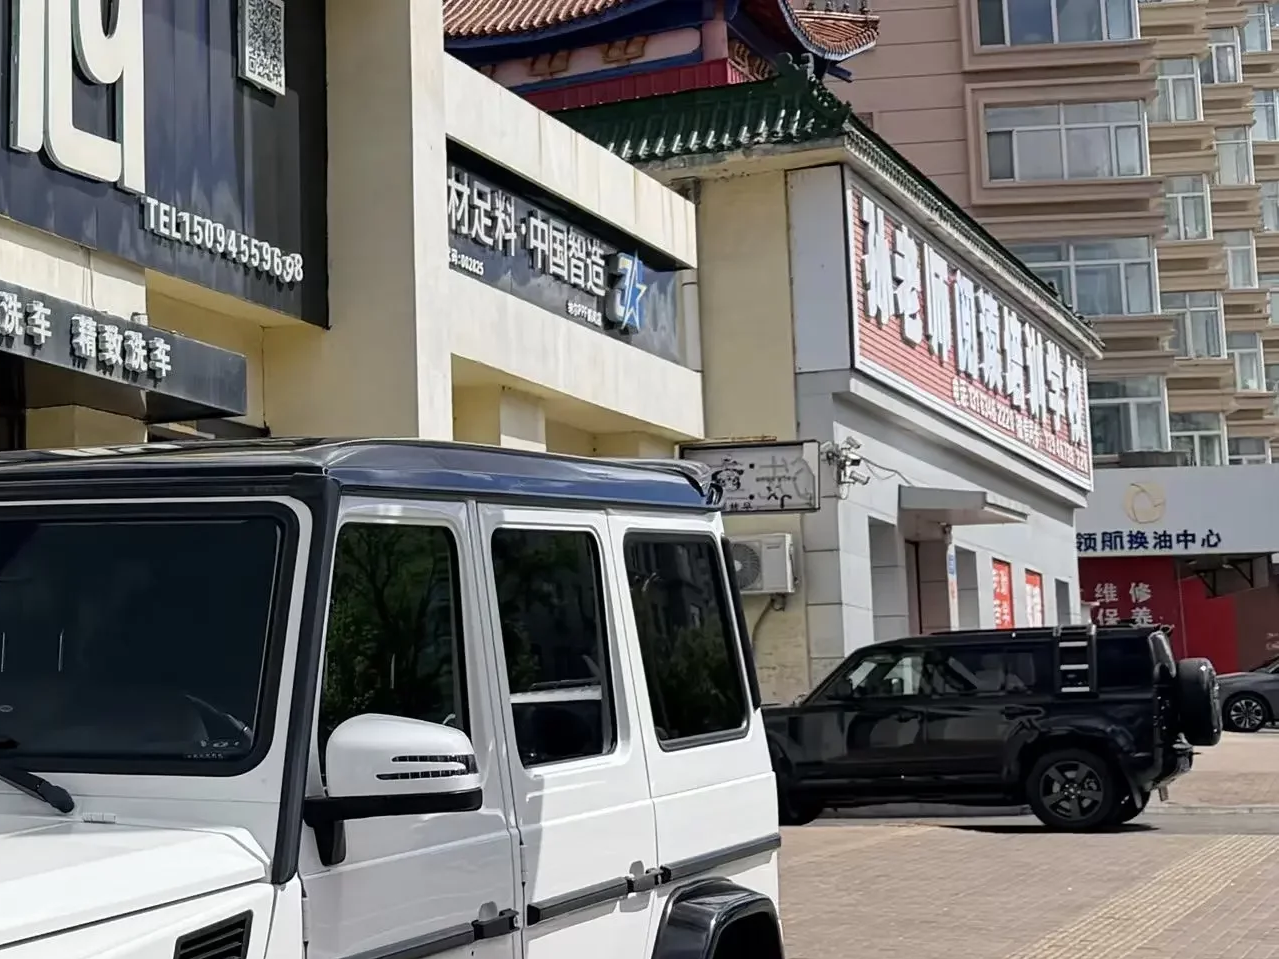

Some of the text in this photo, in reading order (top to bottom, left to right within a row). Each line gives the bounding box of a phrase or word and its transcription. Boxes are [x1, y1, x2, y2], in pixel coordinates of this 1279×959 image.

[143, 195, 304, 283] TEL15094559698
[71, 313, 172, 378] 精致洗车
[1094, 581, 1153, 604] 维修
